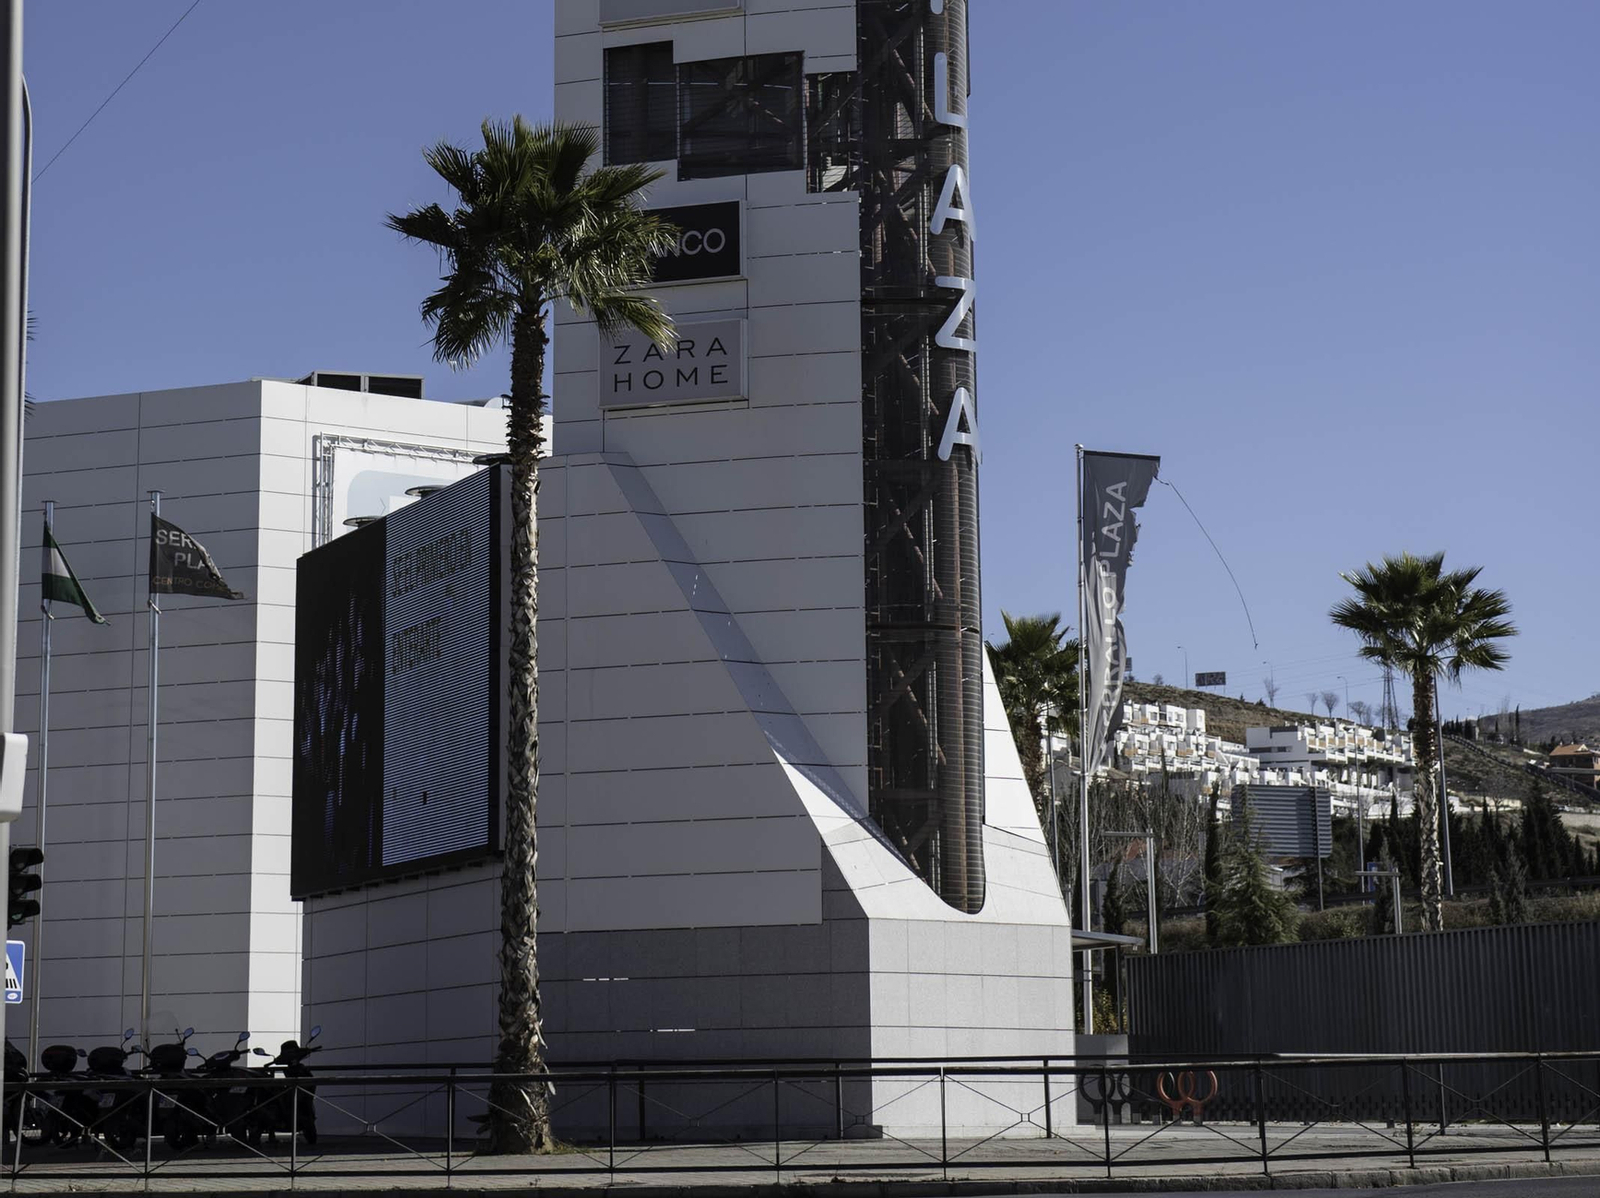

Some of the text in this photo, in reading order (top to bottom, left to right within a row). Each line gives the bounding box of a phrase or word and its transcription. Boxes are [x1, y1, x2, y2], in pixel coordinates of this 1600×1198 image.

[614, 337, 728, 365] ZARA
[614, 364, 728, 393] HOME
[1099, 480, 1128, 577] PLAZA
[152, 575, 193, 587] CENTRO
